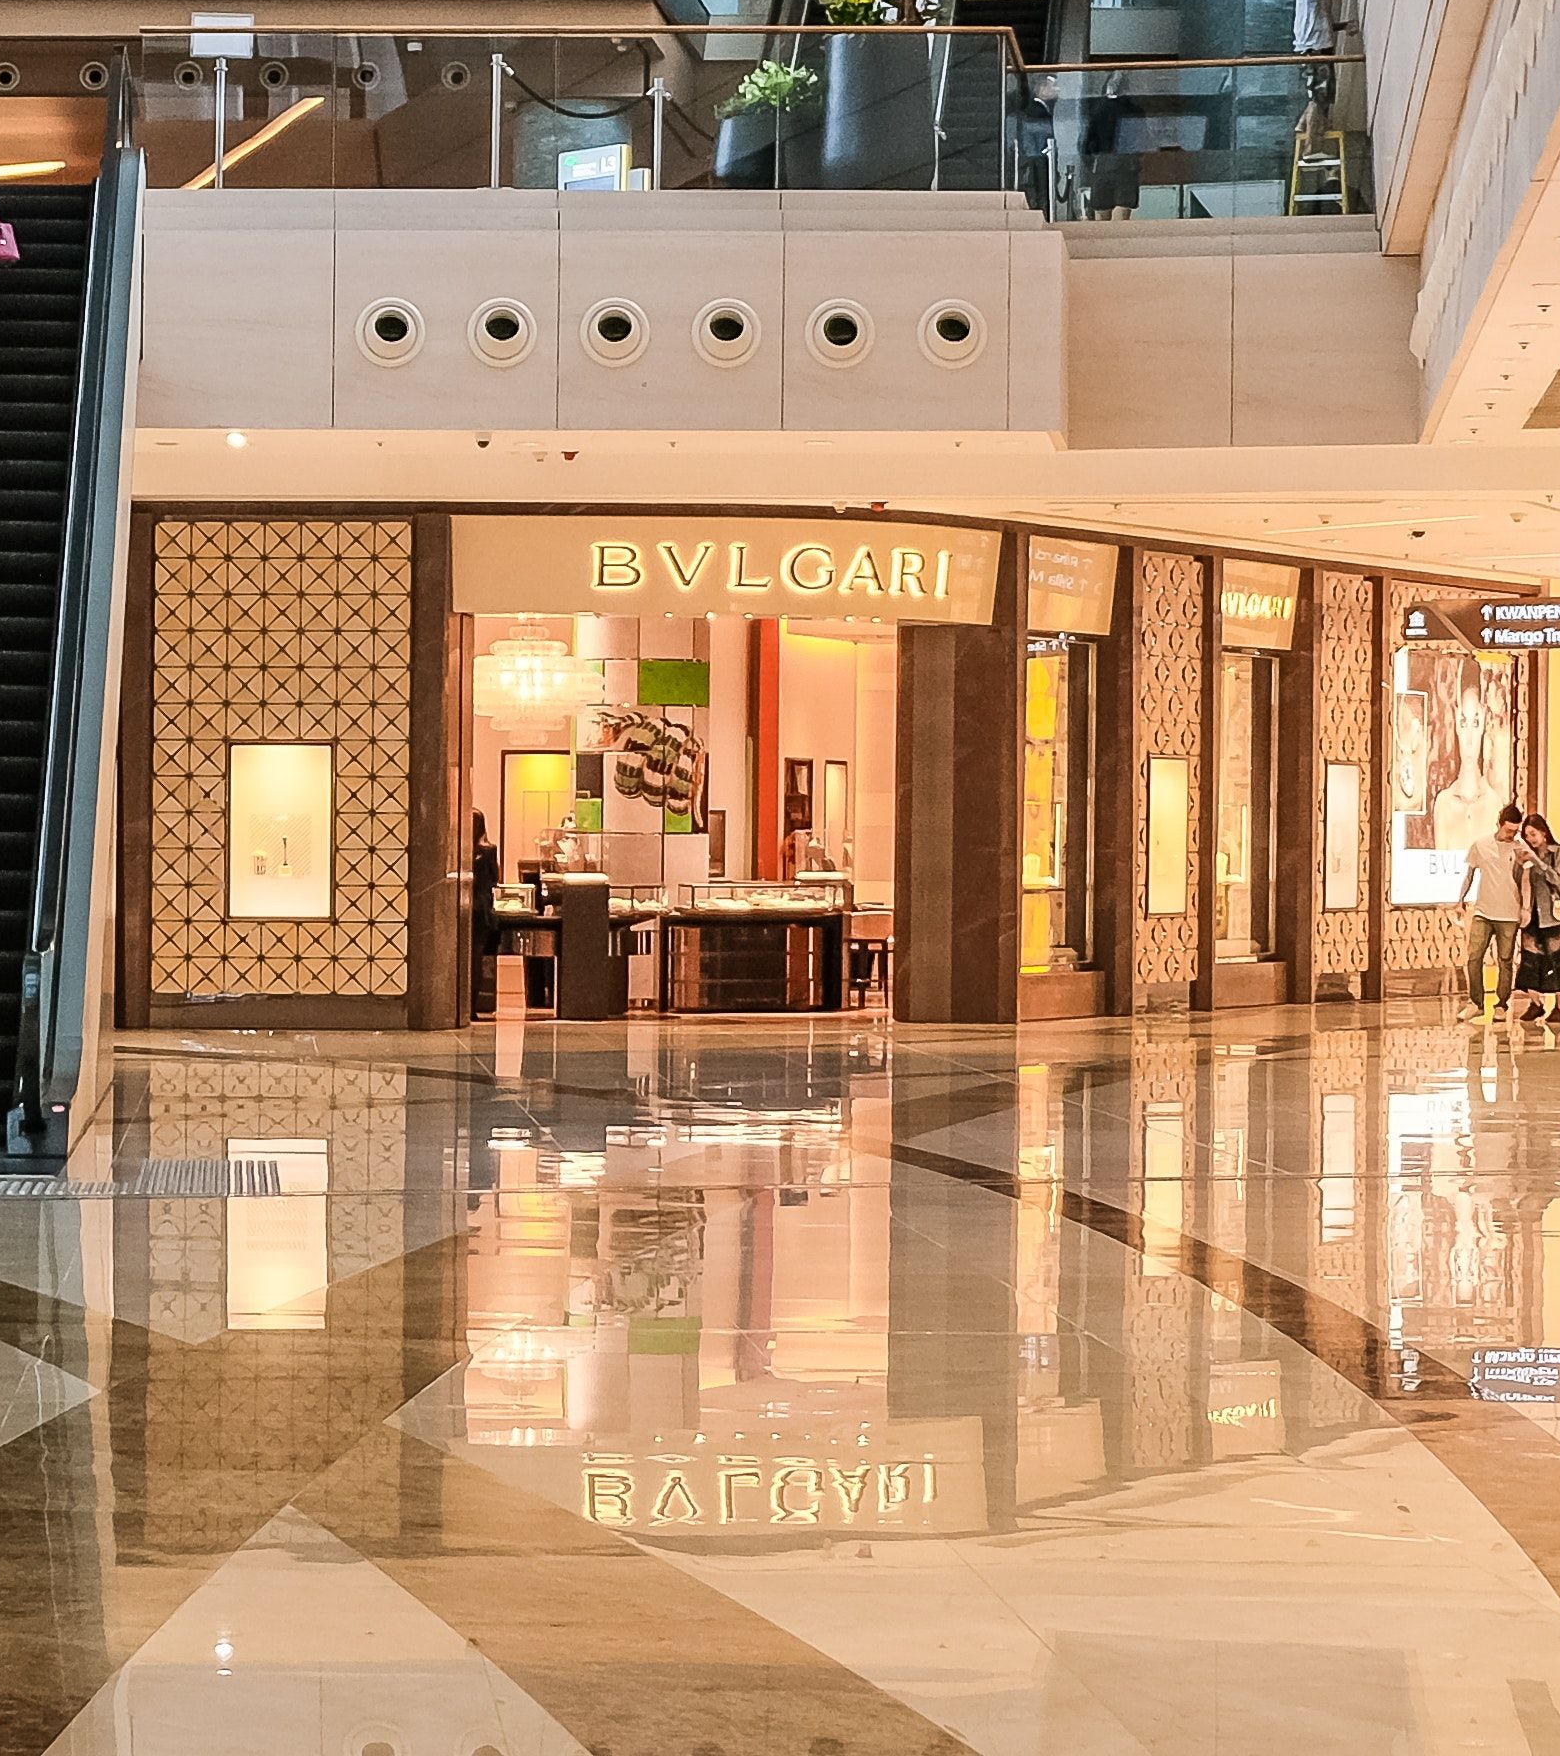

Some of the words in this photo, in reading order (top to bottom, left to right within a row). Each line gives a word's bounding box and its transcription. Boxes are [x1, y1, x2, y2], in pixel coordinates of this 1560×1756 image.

[589, 540, 954, 598] BVLGARI
[1494, 628, 1543, 645] Mango
[1428, 853, 1468, 875] BVL
